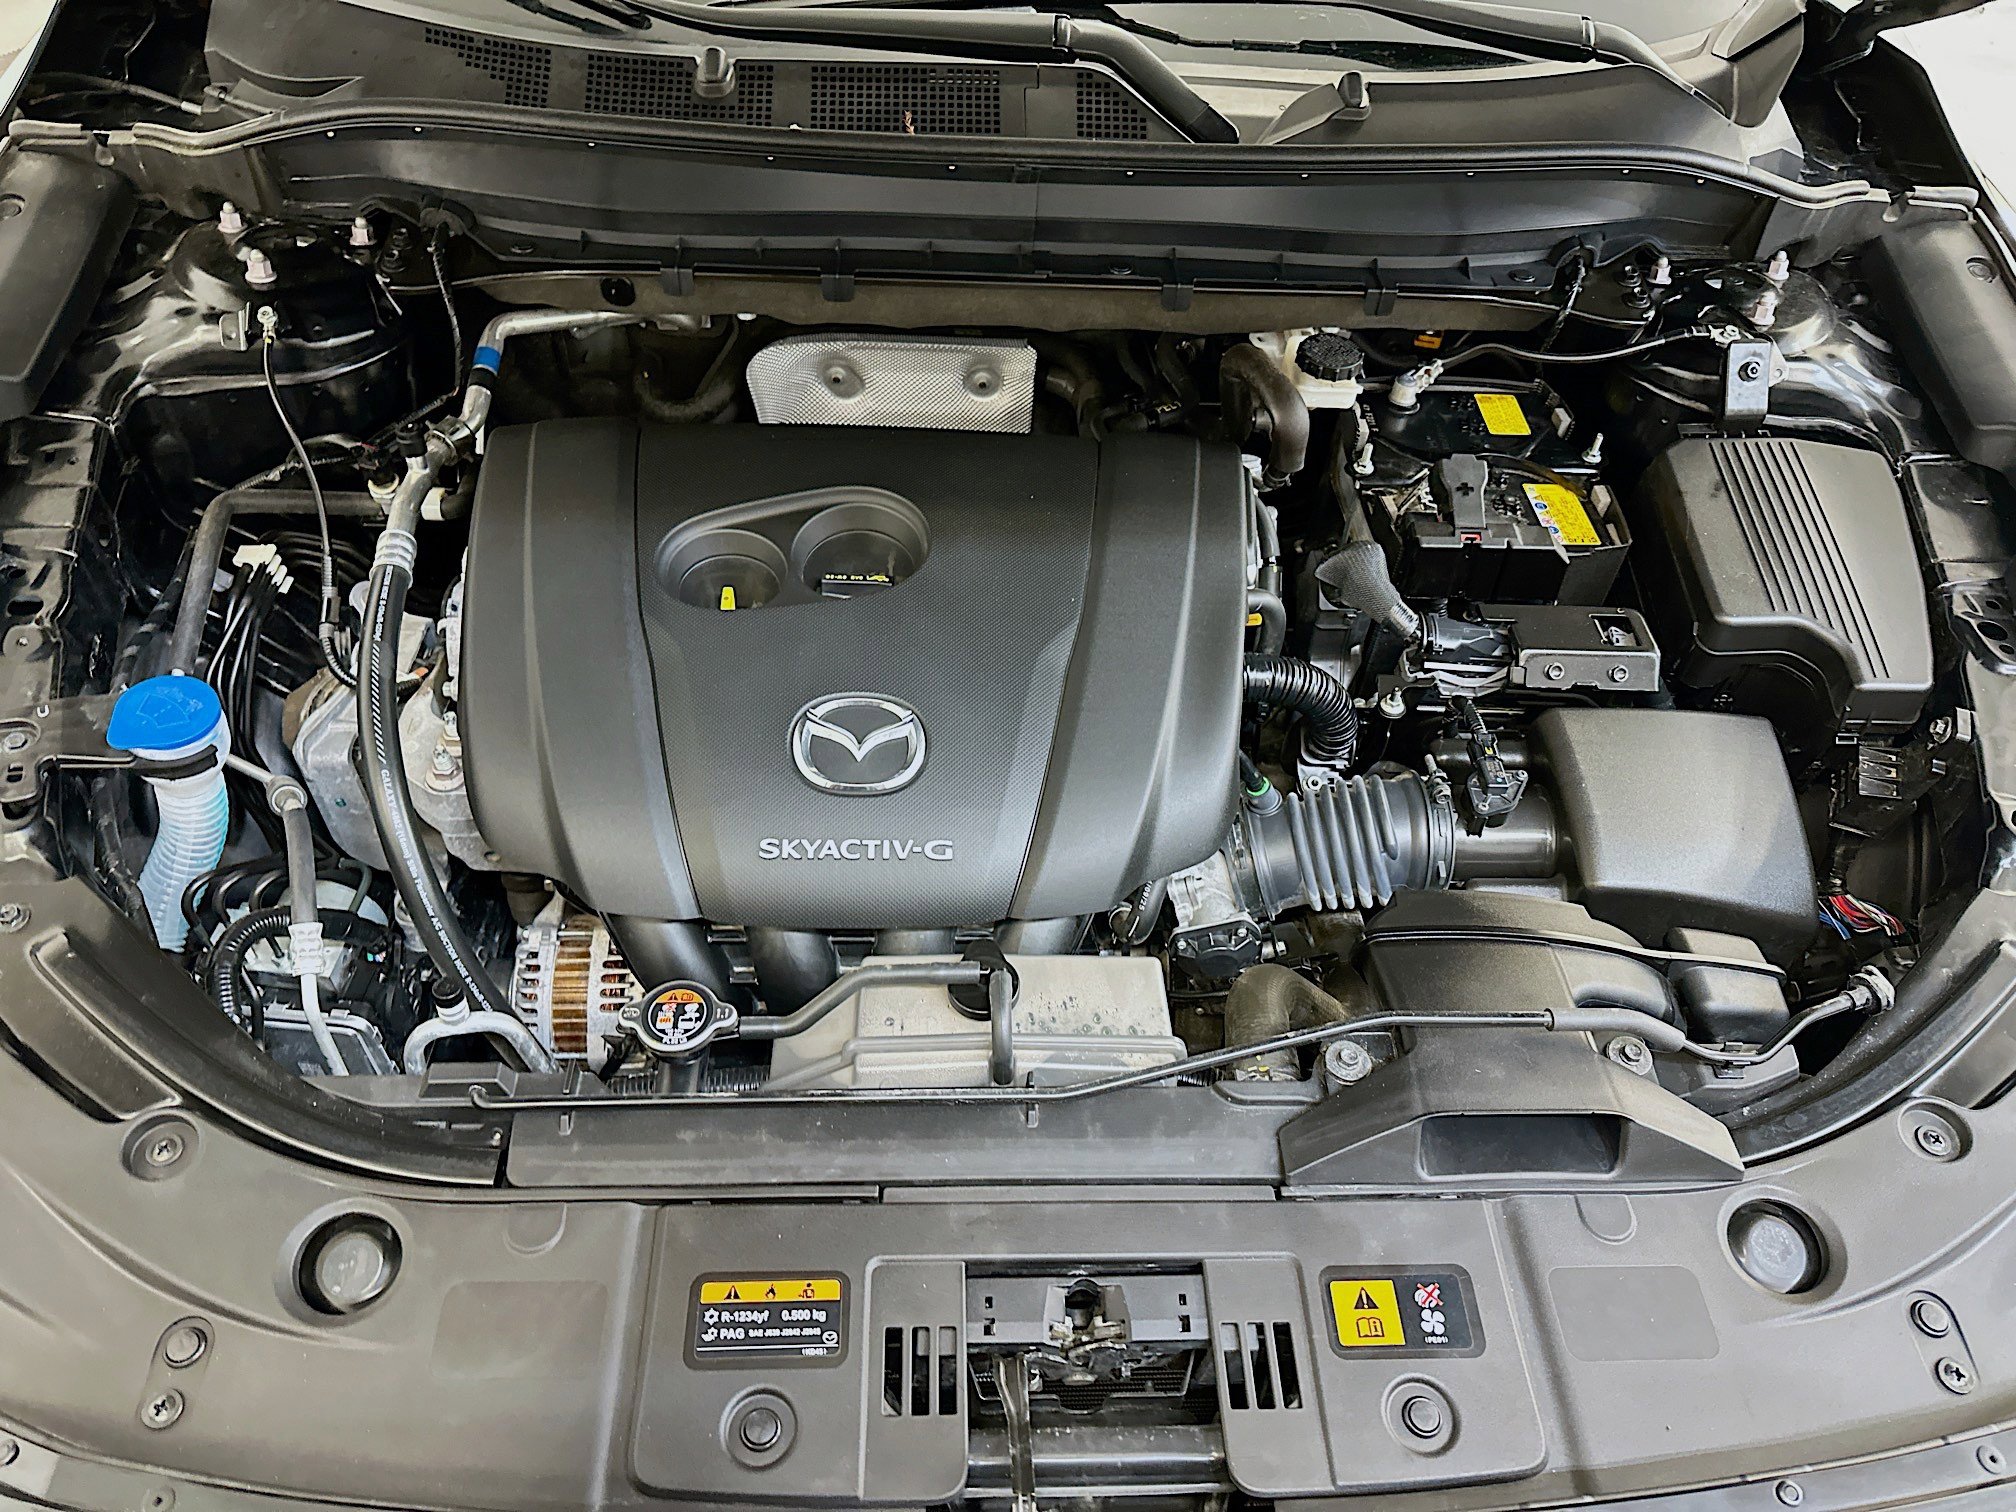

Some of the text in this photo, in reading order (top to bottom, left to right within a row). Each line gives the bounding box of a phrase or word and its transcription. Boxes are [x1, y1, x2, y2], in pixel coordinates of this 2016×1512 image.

[758, 838, 953, 861] SKYACTIV-G
[380, 769, 396, 808] GALAXY
[437, 929, 458, 960] SUCTION
[454, 958, 468, 977] HOSE
[721, 1309, 827, 1324] R-1234yf 0.500 kg
[720, 1328, 745, 1340] PAG
